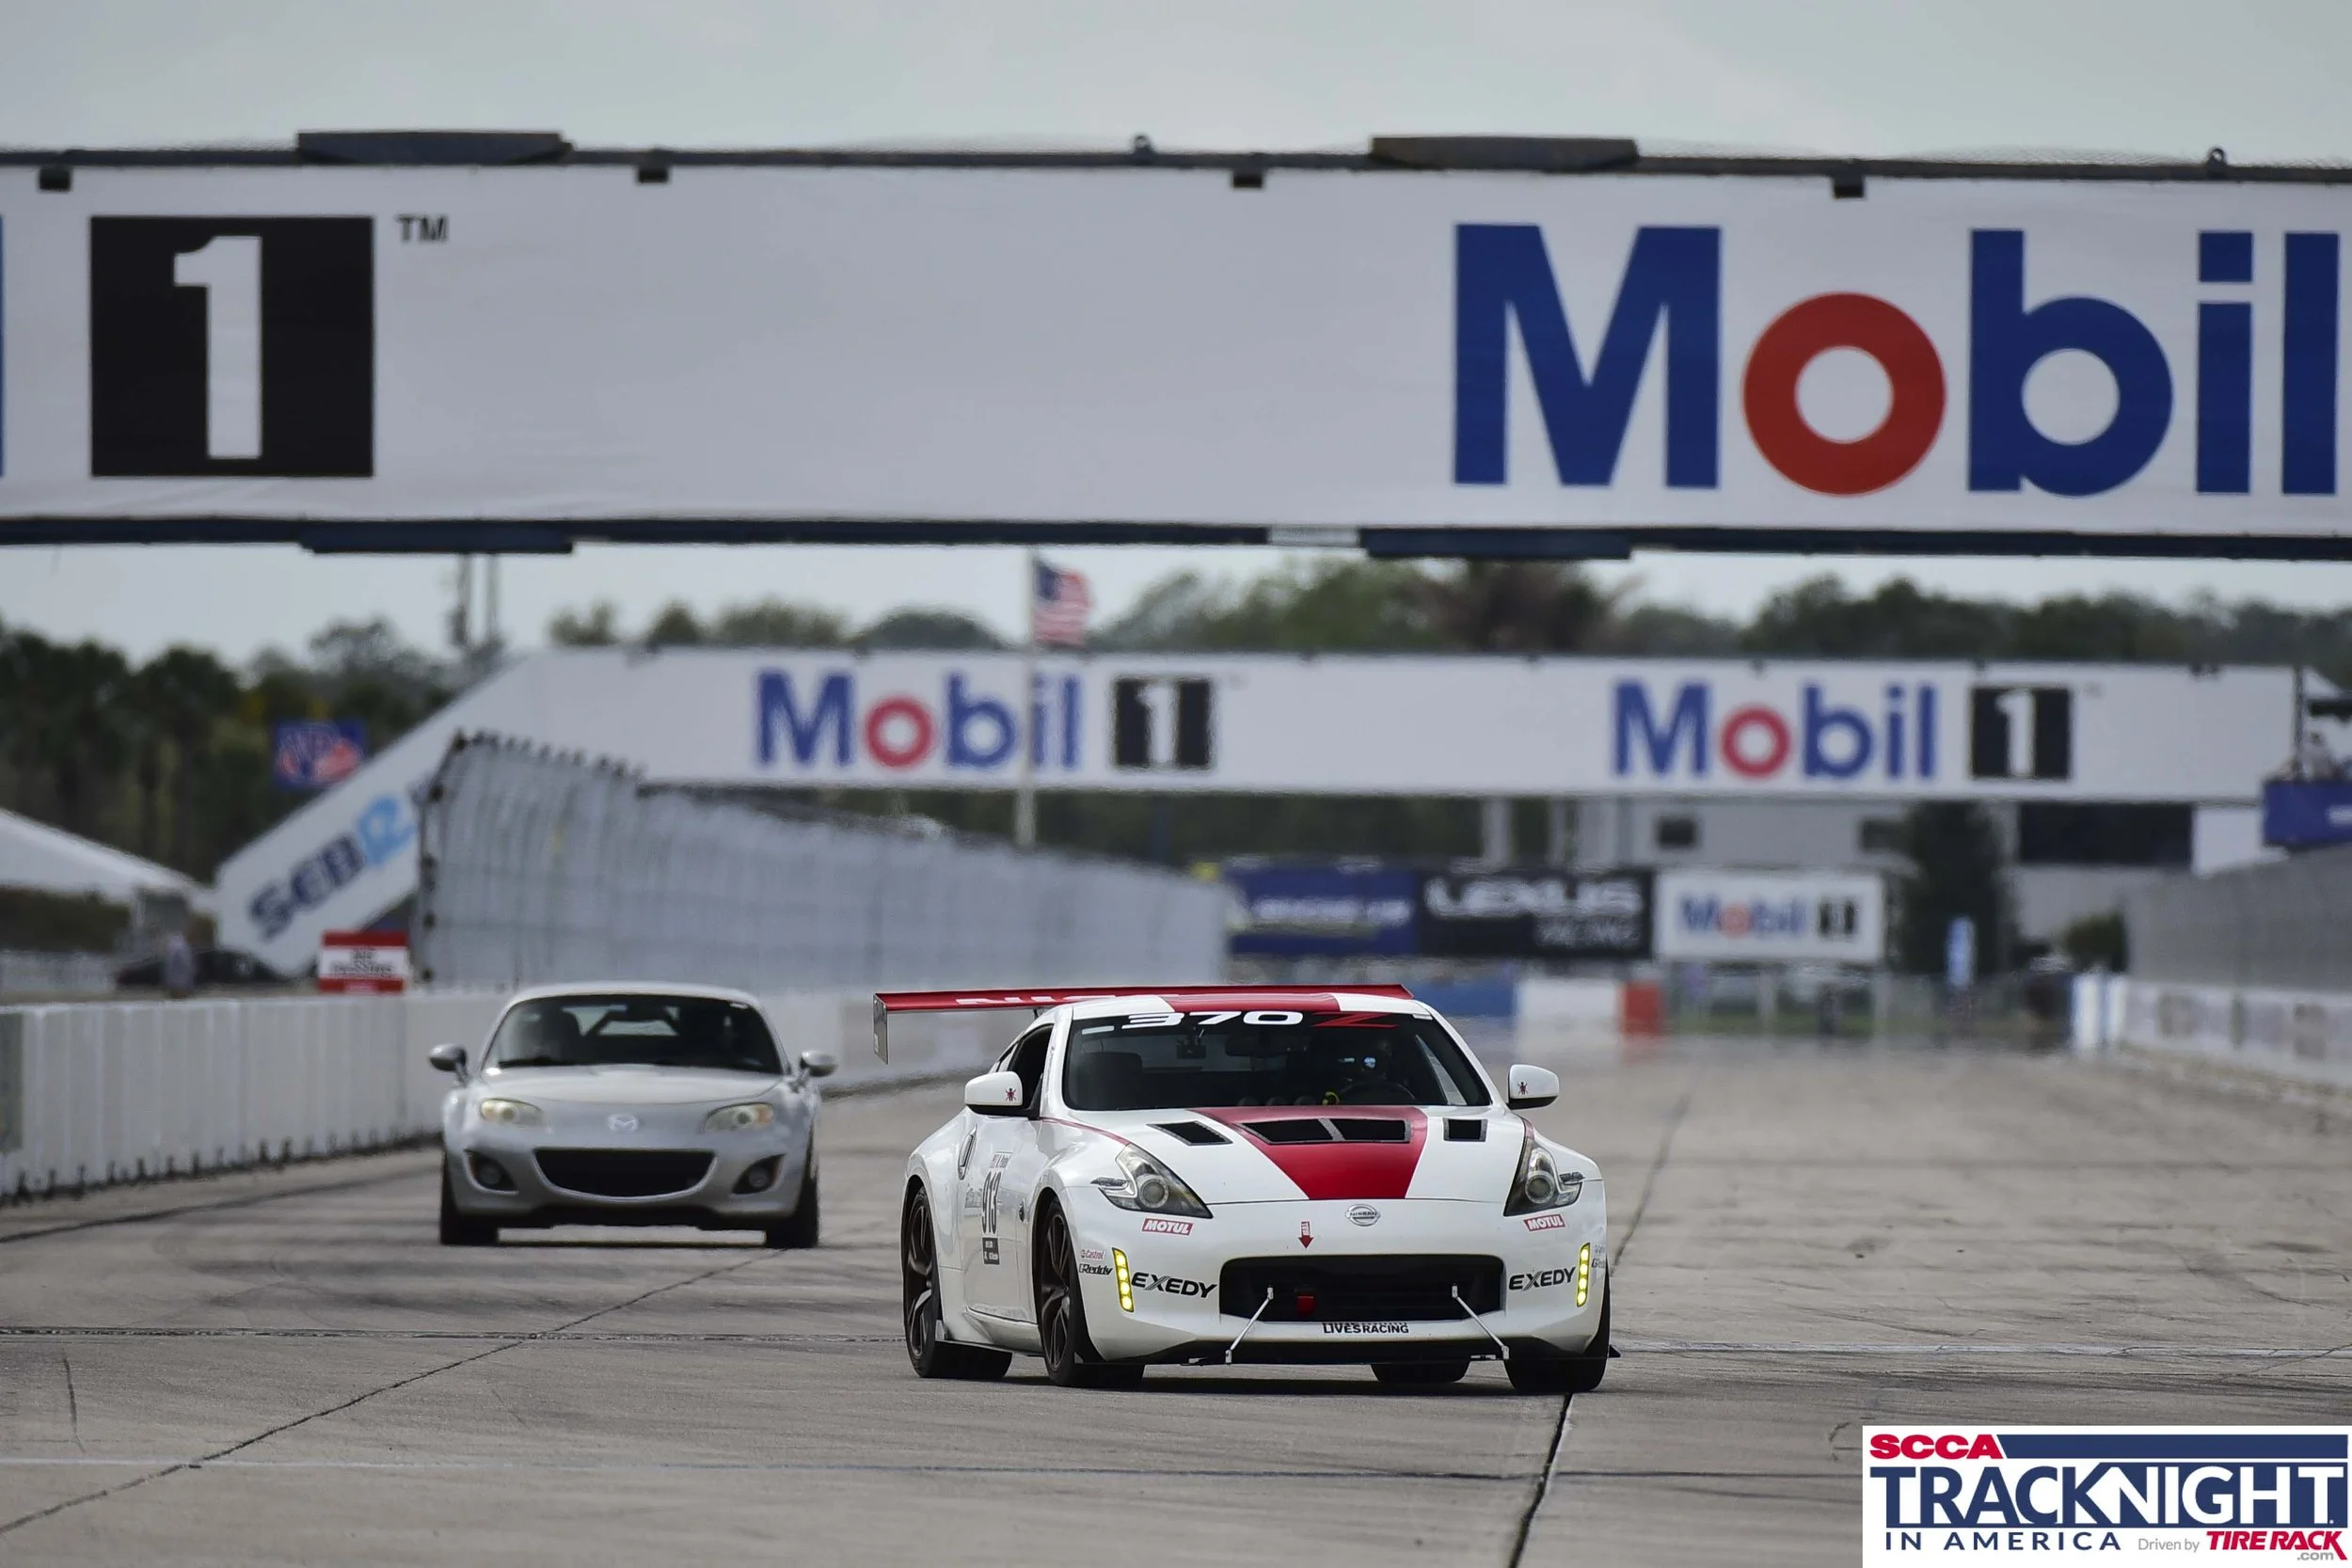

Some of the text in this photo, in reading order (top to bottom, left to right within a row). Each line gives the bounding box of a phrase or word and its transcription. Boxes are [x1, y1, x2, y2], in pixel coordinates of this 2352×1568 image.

[397, 214, 449, 242] TM
[1453, 223, 2340, 497] Mobil
[757, 672, 1081, 769] Mobil
[1613, 679, 1936, 780] Mobil
[1680, 894, 1808, 938] Mobil
[1144, 1219, 1192, 1234] MOTUL
[1526, 1215, 1564, 1231] MOTUL
[1131, 1272, 1218, 1298] EXEDY
[1509, 1267, 1576, 1291] EXEDY
